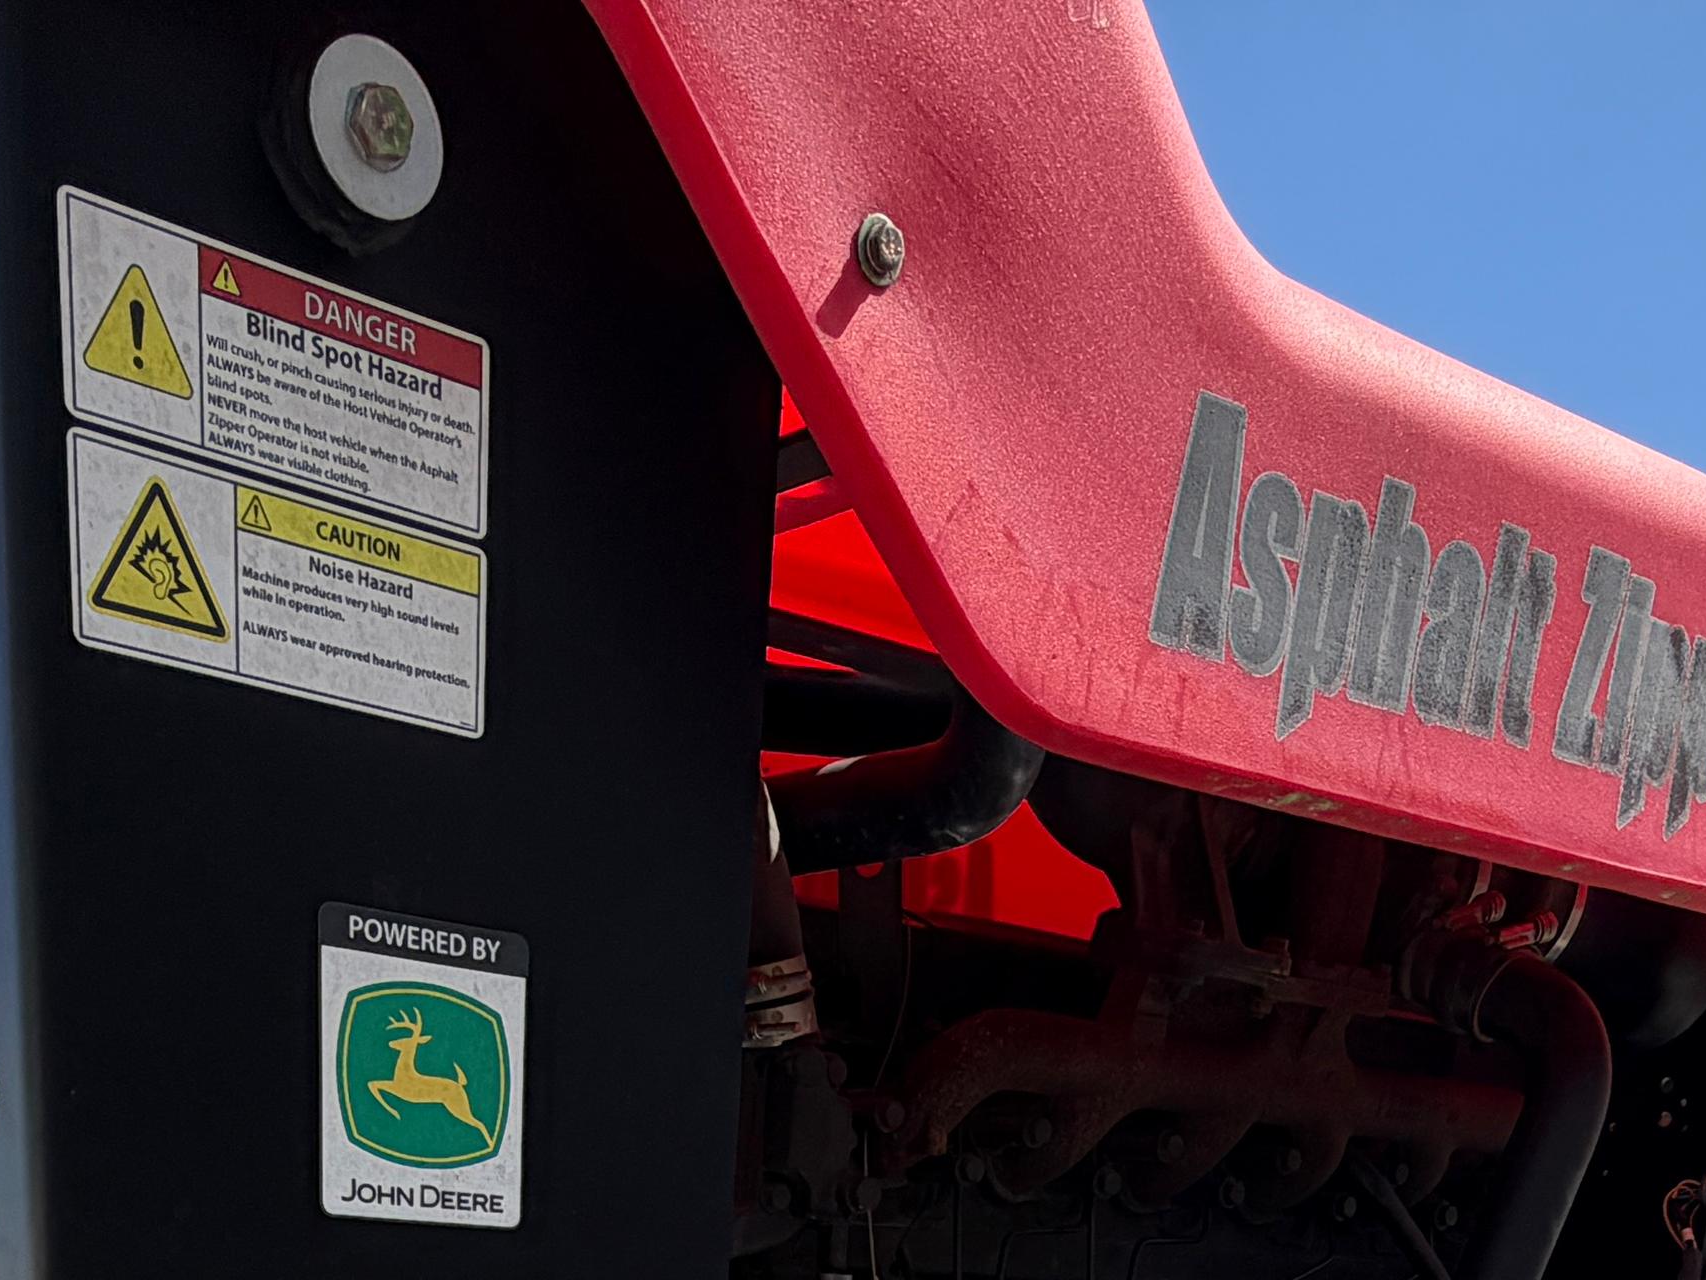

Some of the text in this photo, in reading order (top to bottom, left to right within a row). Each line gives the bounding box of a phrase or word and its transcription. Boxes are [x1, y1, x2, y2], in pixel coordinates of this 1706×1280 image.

[304, 290, 416, 355] DANGER
[205, 333, 475, 435] Will crush, or pinch causing serious injury or death.
[246, 311, 442, 401] Blind Spot Hazard
[206, 371, 273, 406] blind spots.
[206, 352, 462, 449] ALWAYS be aware of the Host Vehicle Operator's
[207, 391, 458, 485] NEVER move the host vehicle when the Asphalt
[207, 410, 369, 474] Zipper Operator is not visible.
[207, 430, 371, 494] ALWAYS wear visible clothing.
[315, 520, 400, 562] CAUTION
[1149, 391, 1557, 749] Asphalt
[241, 564, 459, 636] Machine produces very high sound levels
[242, 585, 345, 622] while in operation.
[308, 554, 413, 600] Noise Hazard
[242, 619, 470, 689] ALWAYS wear approved hearing protection.
[349, 915, 501, 963] POWERED BY
[341, 1178, 504, 1213] JOHN DEERE
